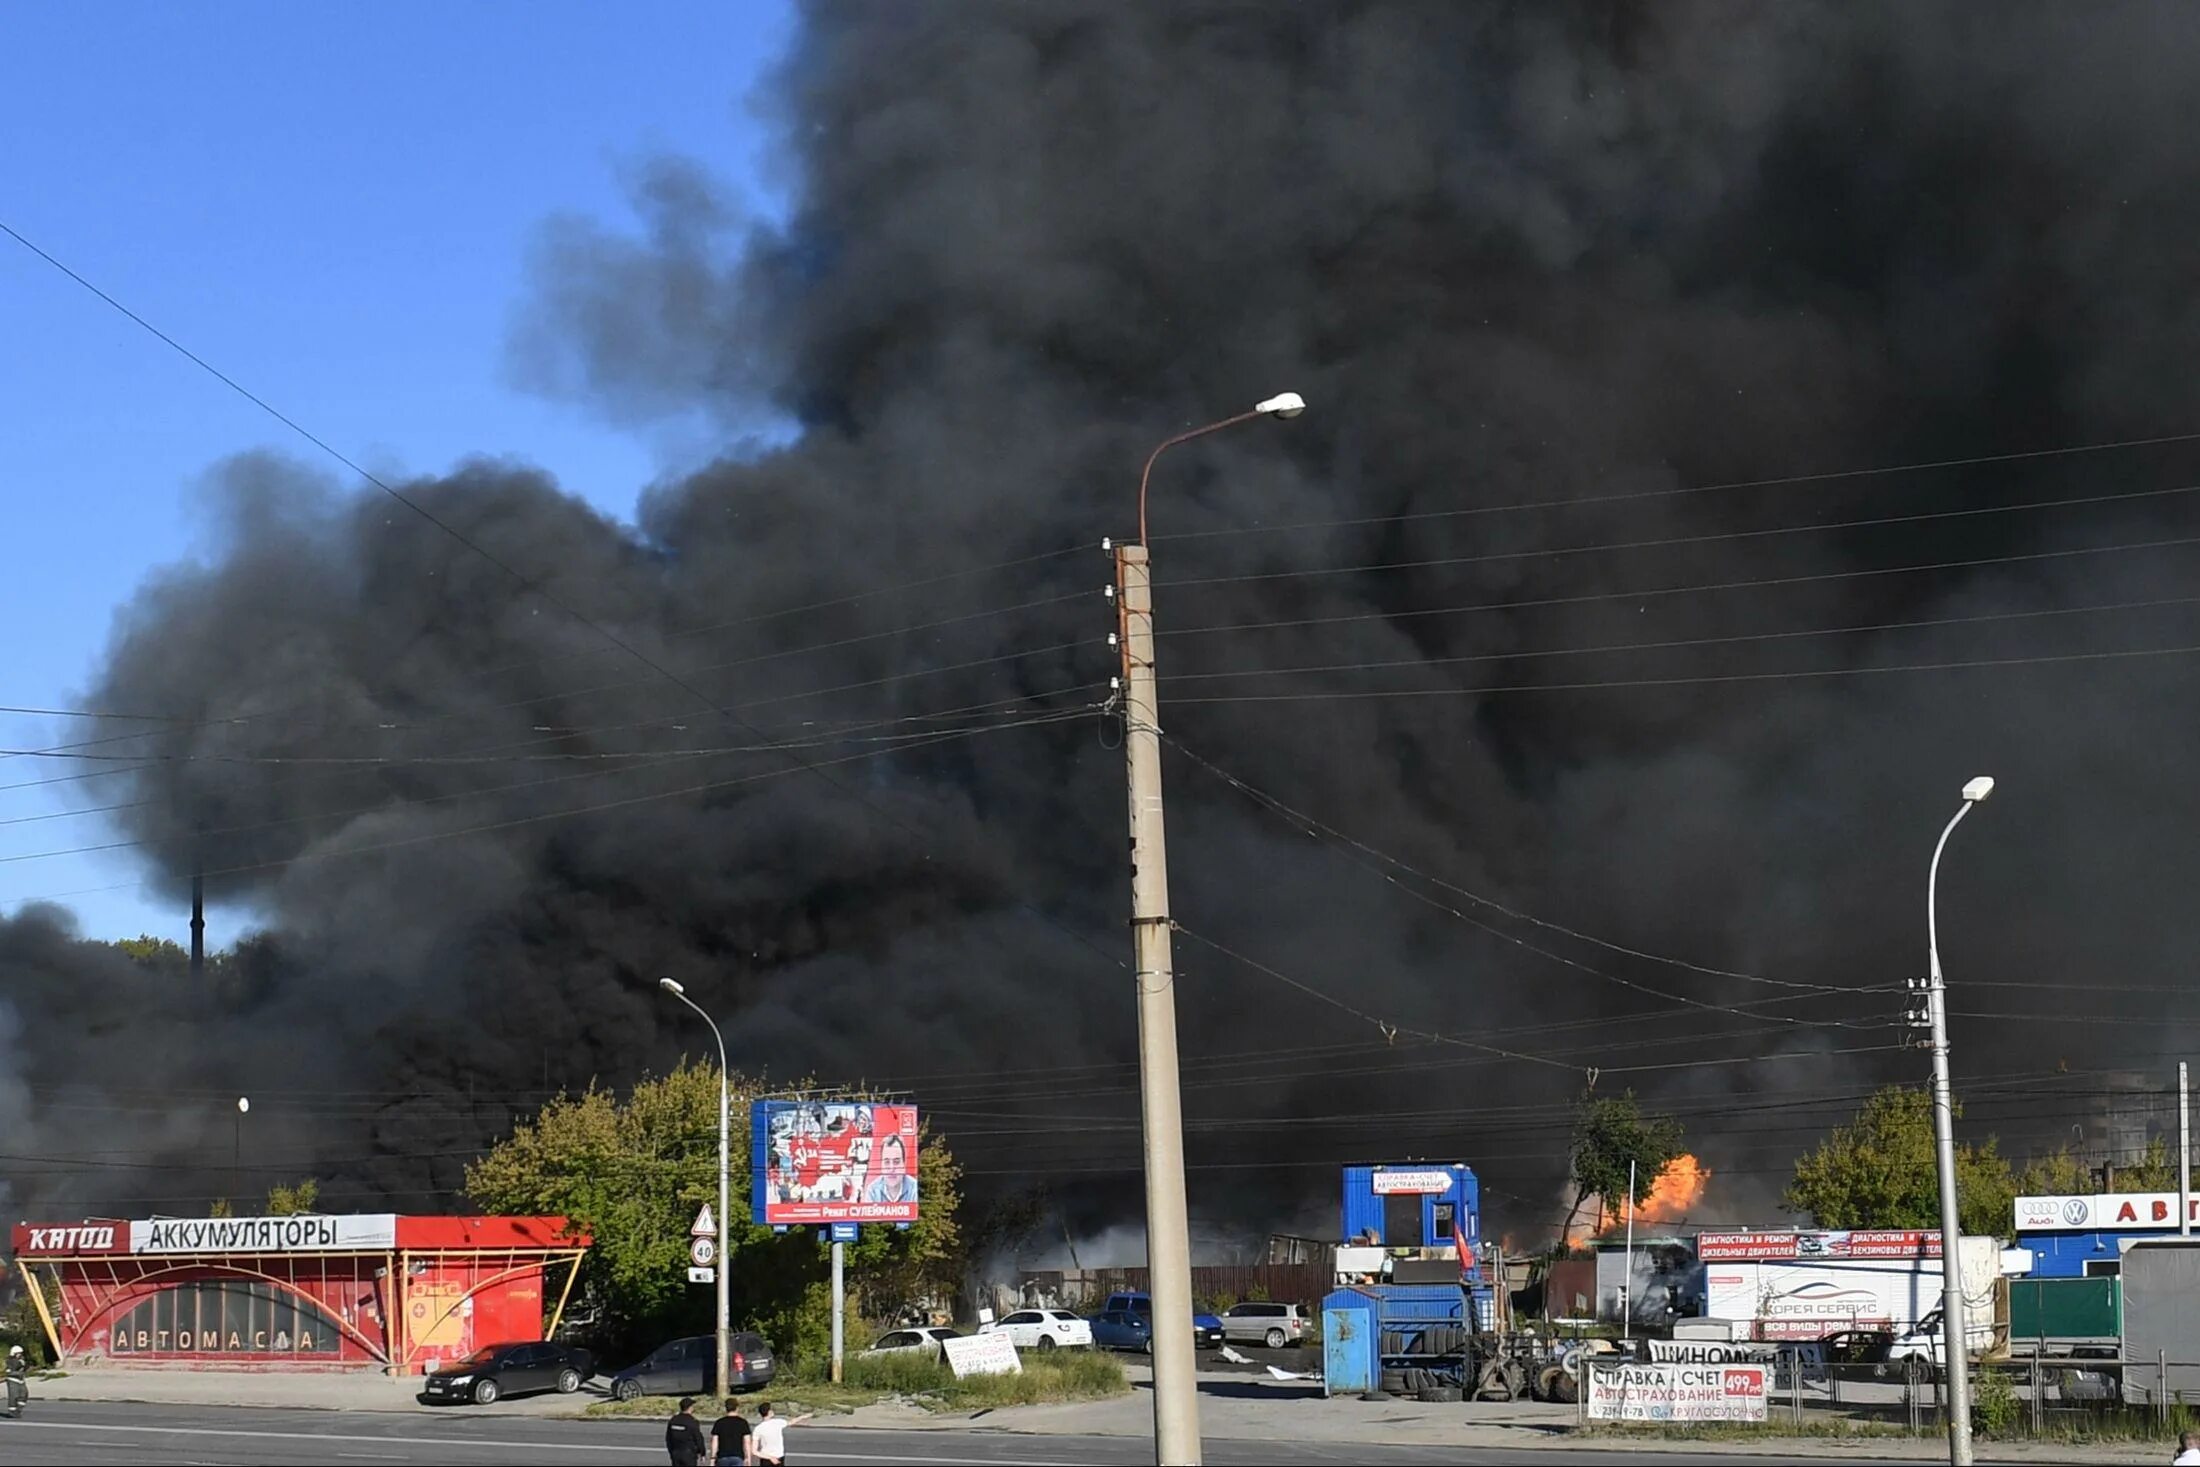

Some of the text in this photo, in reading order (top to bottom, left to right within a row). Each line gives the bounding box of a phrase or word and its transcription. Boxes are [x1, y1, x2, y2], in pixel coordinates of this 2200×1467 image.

[849, 1204, 910, 1217] СУЛЕЙМАНОВ
[2027, 1217, 2054, 1225] Audi
[29, 1227, 114, 1250] КАТОД
[150, 1219, 337, 1249] АККУМУЛЯТОРЫ
[1701, 1235, 1754, 1245] ДИАГНОСТИКА
[1764, 1234, 1795, 1244] РЕМОНТ
[1852, 1233, 1905, 1243] ДИАГНОСТИКА
[1908, 1233, 1915, 1241] И
[697, 1246, 711, 1258] 40
[1701, 1247, 1746, 1257] ДИЗЕЛЬНЫХ
[1747, 1246, 1794, 1256] ДВИГАТЕЛЕЙ
[1852, 1246, 1901, 1255] БЕНЗИНОВЫХ
[1816, 1303, 1878, 1313] СЕРВИС
[1764, 1322, 1786, 1332] все
[1789, 1322, 1821, 1332] виды
[1594, 1370, 1666, 1385] СПРАВКА
[1681, 1370, 1721, 1386] СЧЕТ
[1725, 1375, 1750, 1392] 499
[1594, 1388, 1723, 1401] АВТОСТРАХОВАНИЕ
[1670, 1405, 1764, 1418] КРУГЛОСУТОЧНО
